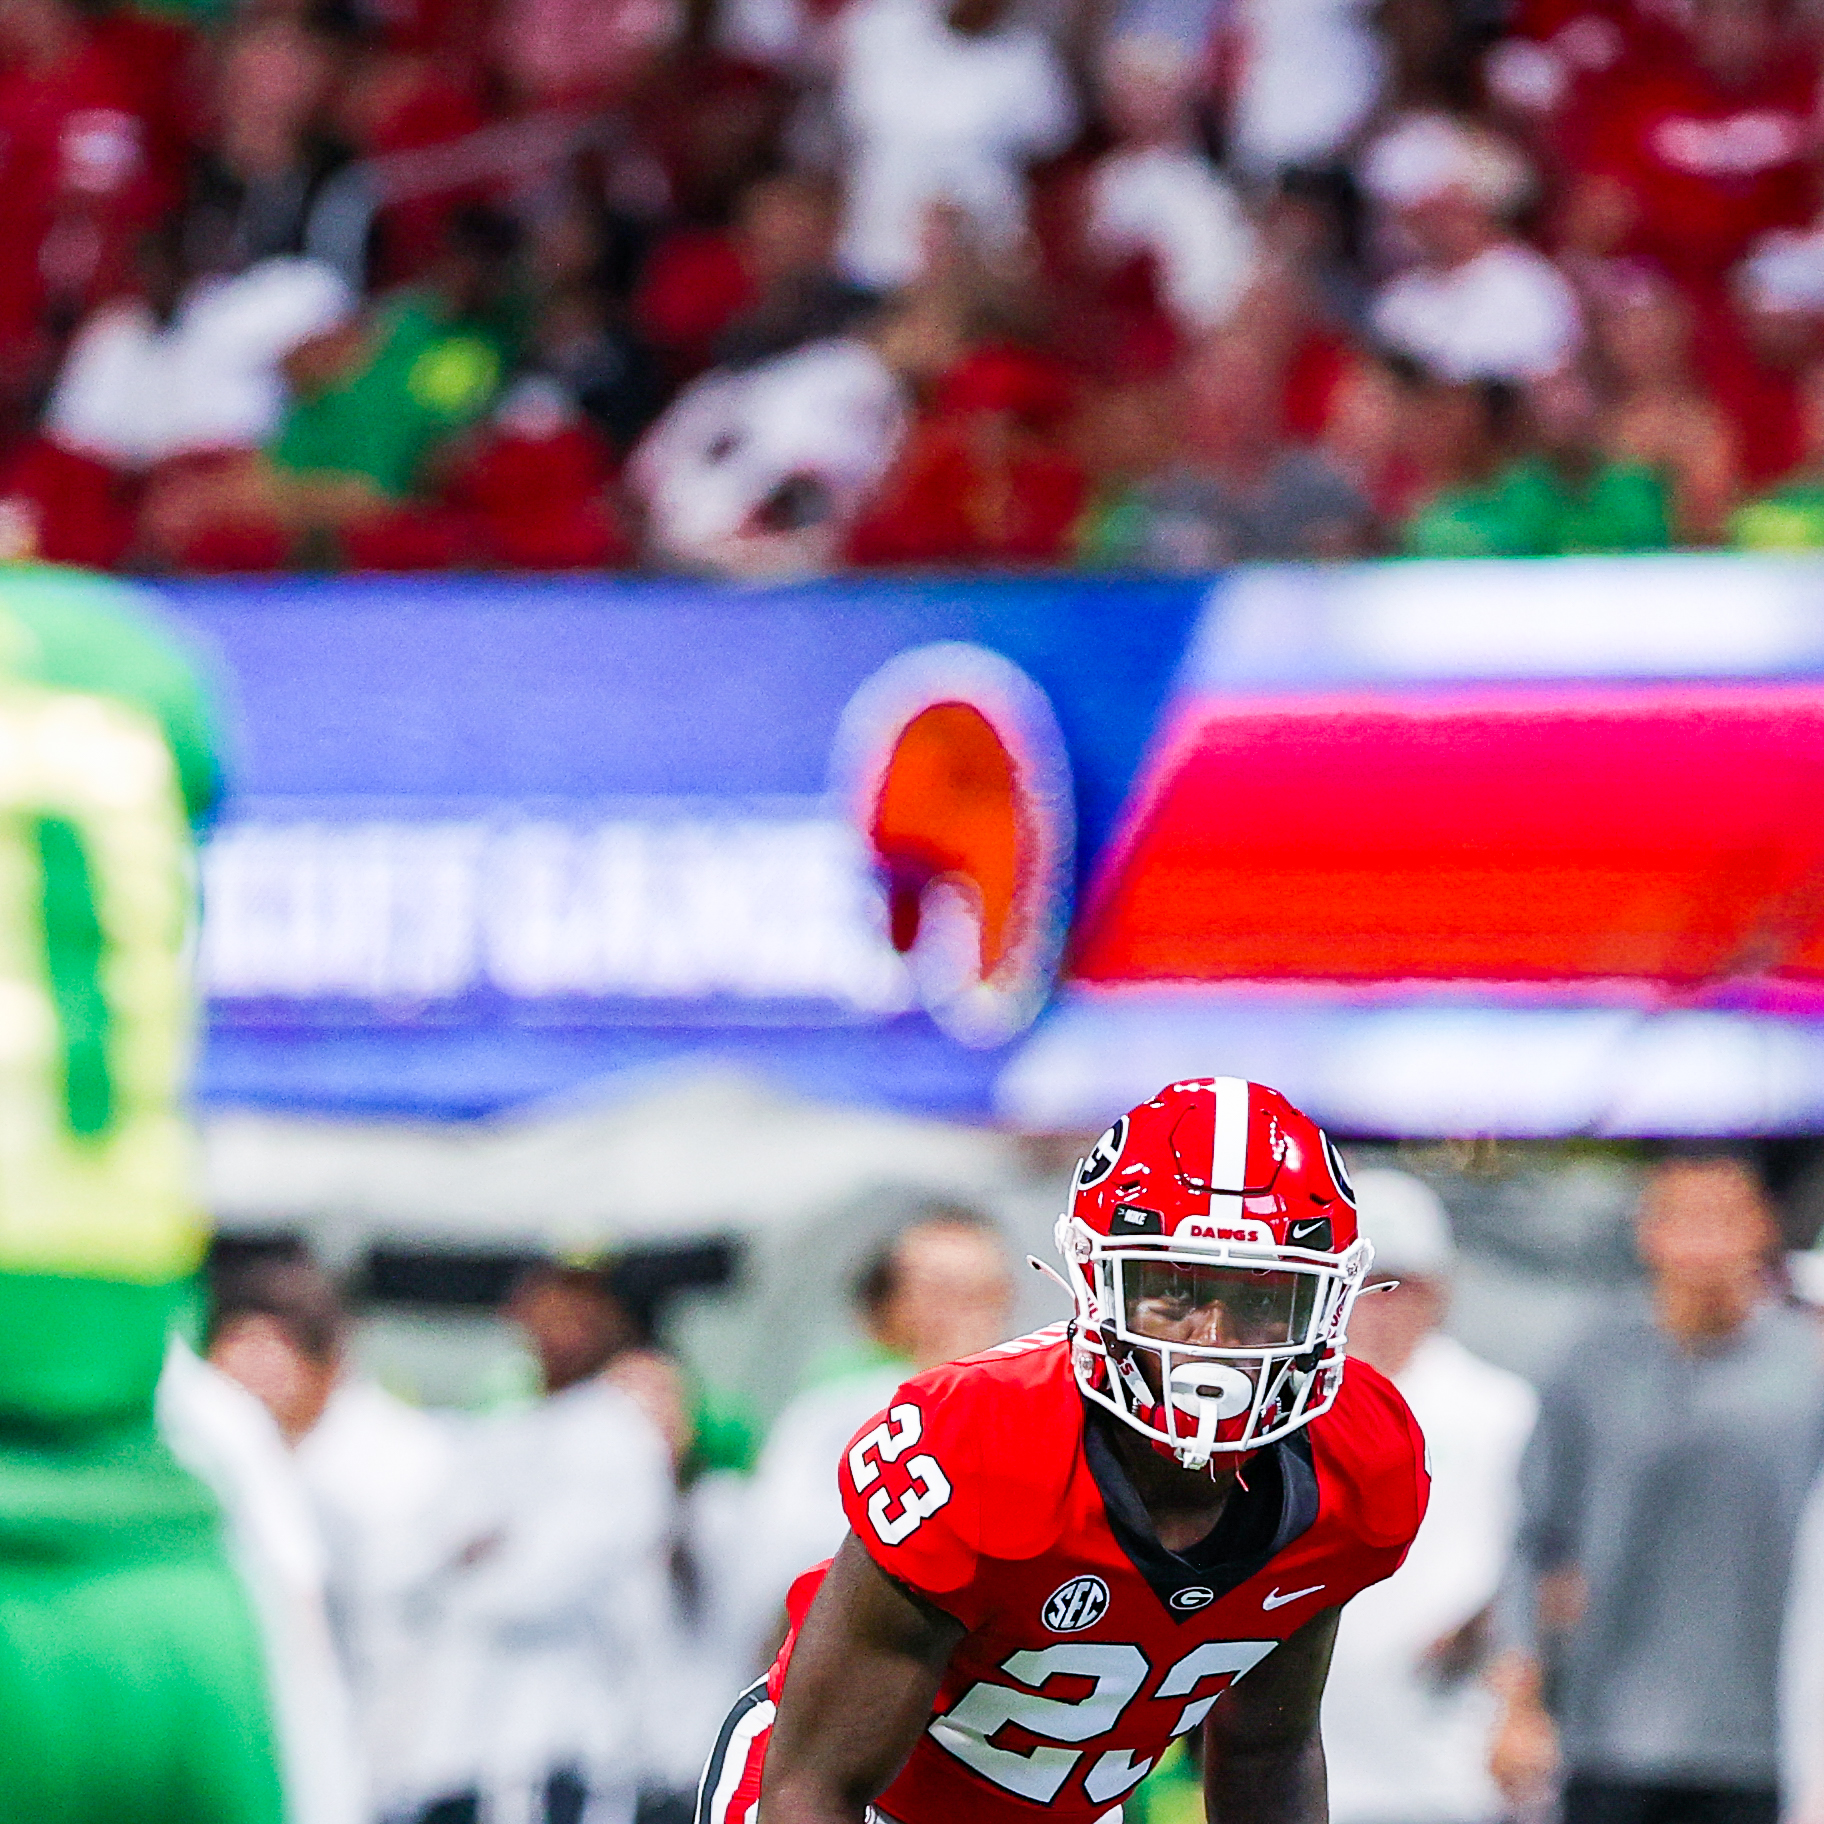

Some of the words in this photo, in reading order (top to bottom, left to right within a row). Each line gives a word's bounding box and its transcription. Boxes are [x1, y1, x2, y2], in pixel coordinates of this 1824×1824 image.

[1190, 1225, 1259, 1242] DAWGS
[848, 1402, 953, 1547] 23
[1047, 1581, 1104, 1629] SEC
[1176, 1589, 1213, 1607] G
[928, 1638, 1284, 1807] 23
